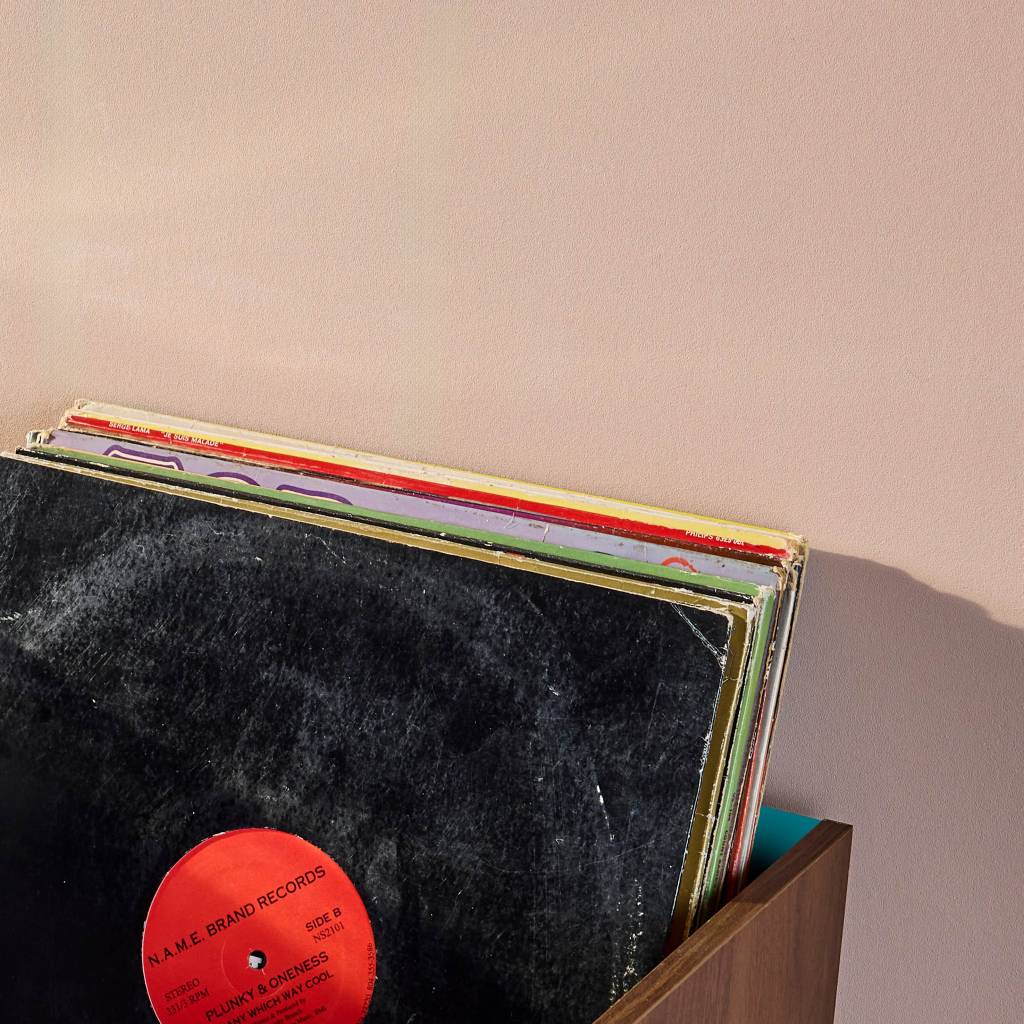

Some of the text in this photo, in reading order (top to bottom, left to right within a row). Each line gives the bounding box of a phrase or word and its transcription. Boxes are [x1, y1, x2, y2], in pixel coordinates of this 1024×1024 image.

[108, 421, 131, 431] SERGE
[132, 425, 151, 434] LAMA
[174, 433, 190, 442] SUIS
[685, 530, 714, 540] PHILIPS
[147, 865, 326, 968] N.A.M.E. BRAND RECORDS
[305, 907, 343, 932] SIDE B
[312, 922, 345, 943] NS2101
[164, 978, 201, 1002] STEREO
[188, 988, 210, 1007] RPM
[205, 951, 330, 1023] PLUNKY & ONENESS
[248, 998, 282, 1018] WHICH
[282, 986, 304, 1000] WAY
[305, 970, 334, 990] COOL
